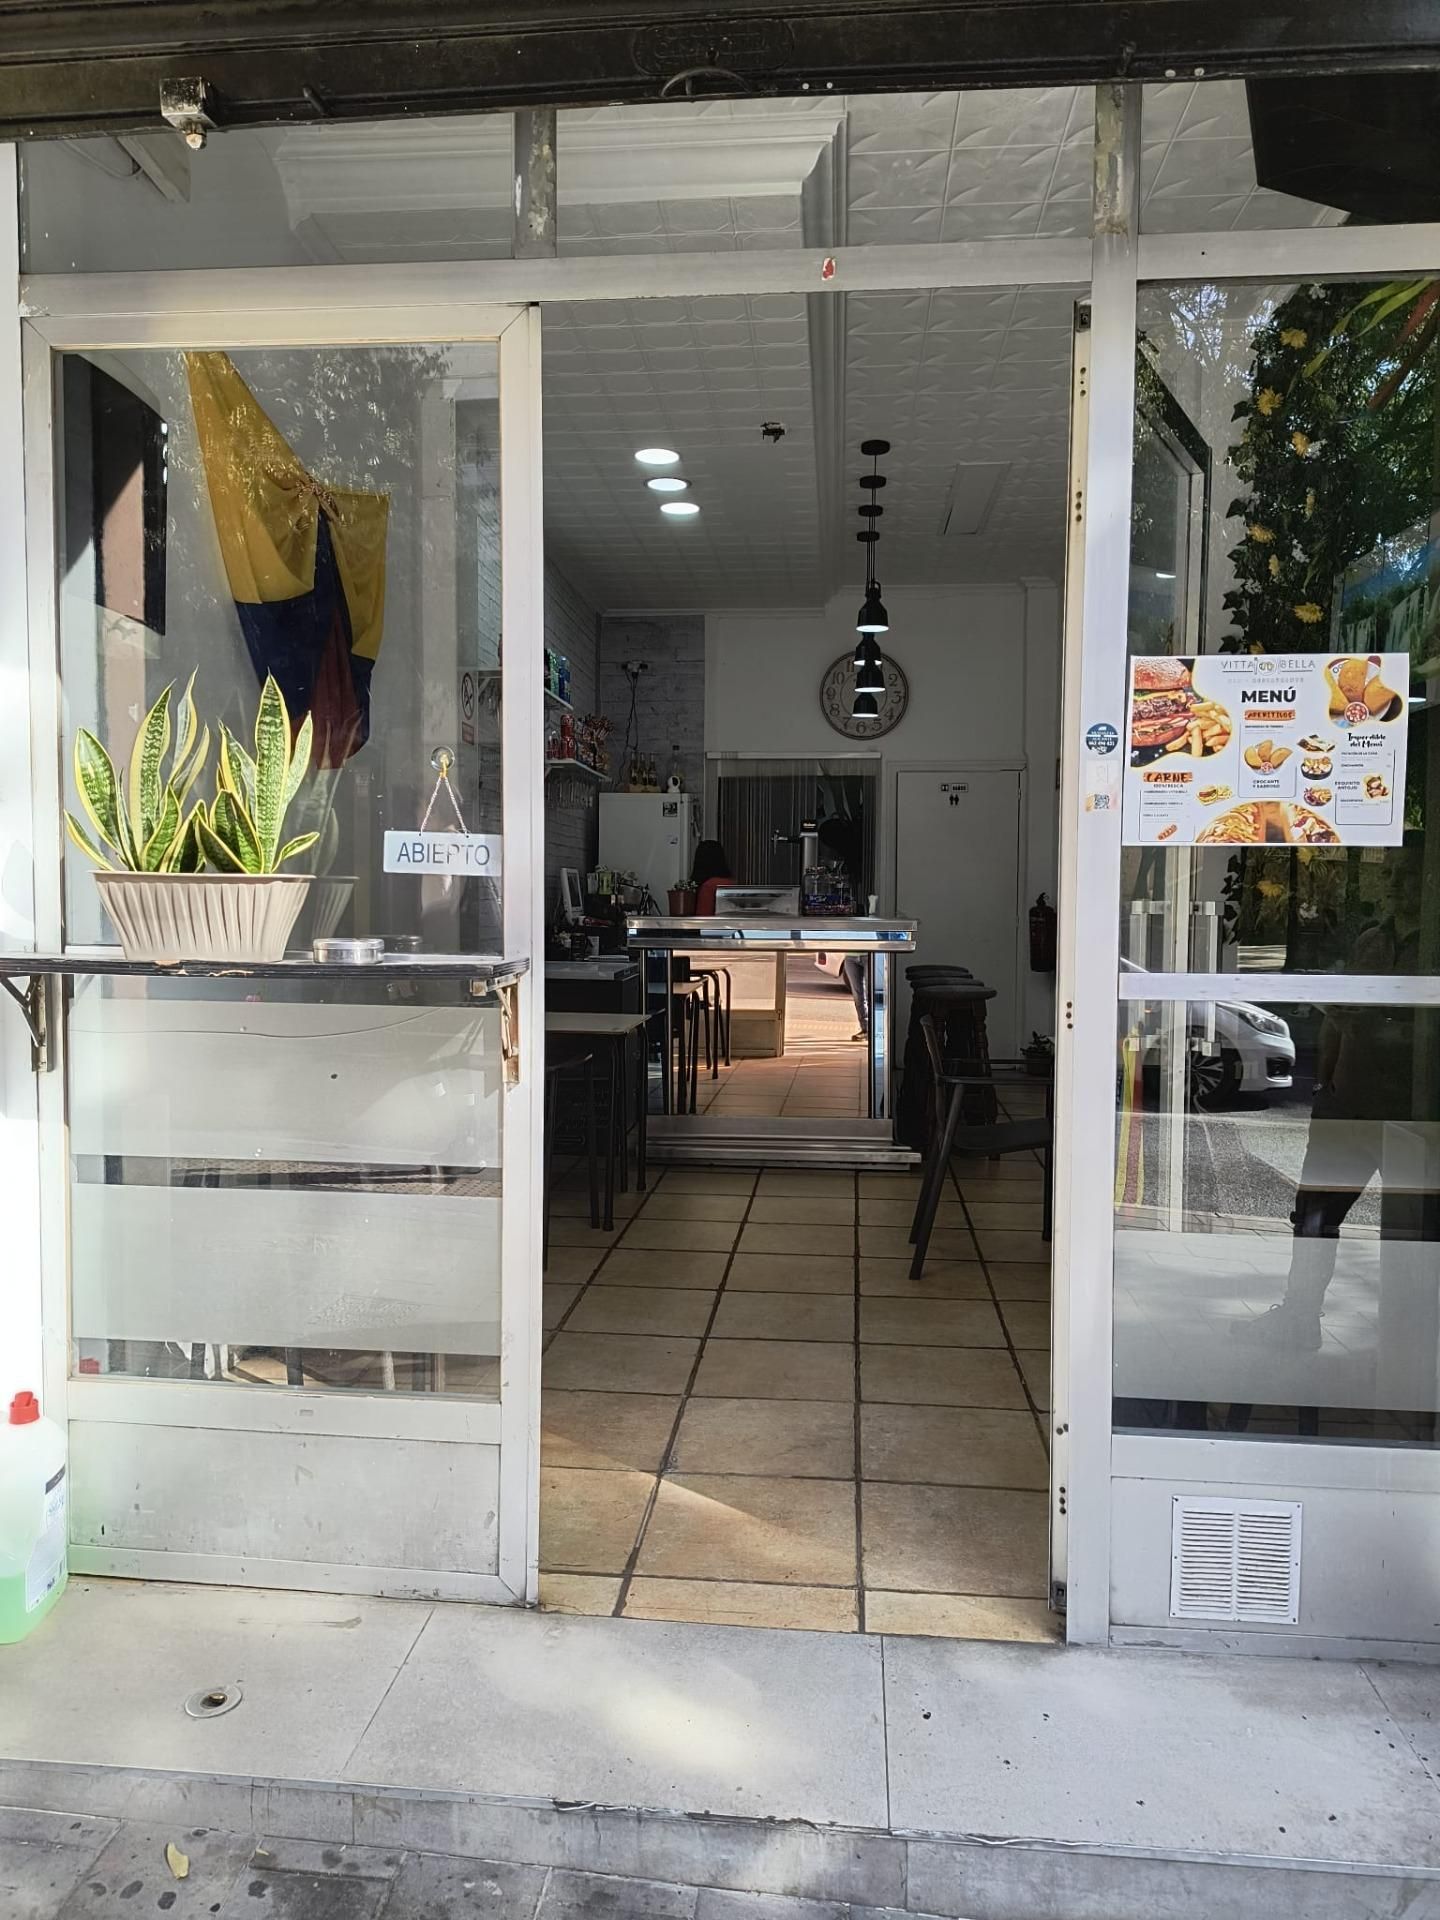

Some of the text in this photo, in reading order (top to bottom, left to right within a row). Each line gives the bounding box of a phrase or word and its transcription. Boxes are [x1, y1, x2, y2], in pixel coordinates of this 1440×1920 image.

[1221, 659, 1316, 669] VITTA BELLA
[832, 672, 845, 684] 10
[826, 687, 836, 700] 9
[1241, 686, 1297, 703] MENÚ
[829, 703, 840, 717] 8
[856, 721, 867, 734] 6
[1146, 772, 1189, 783] CARNE
